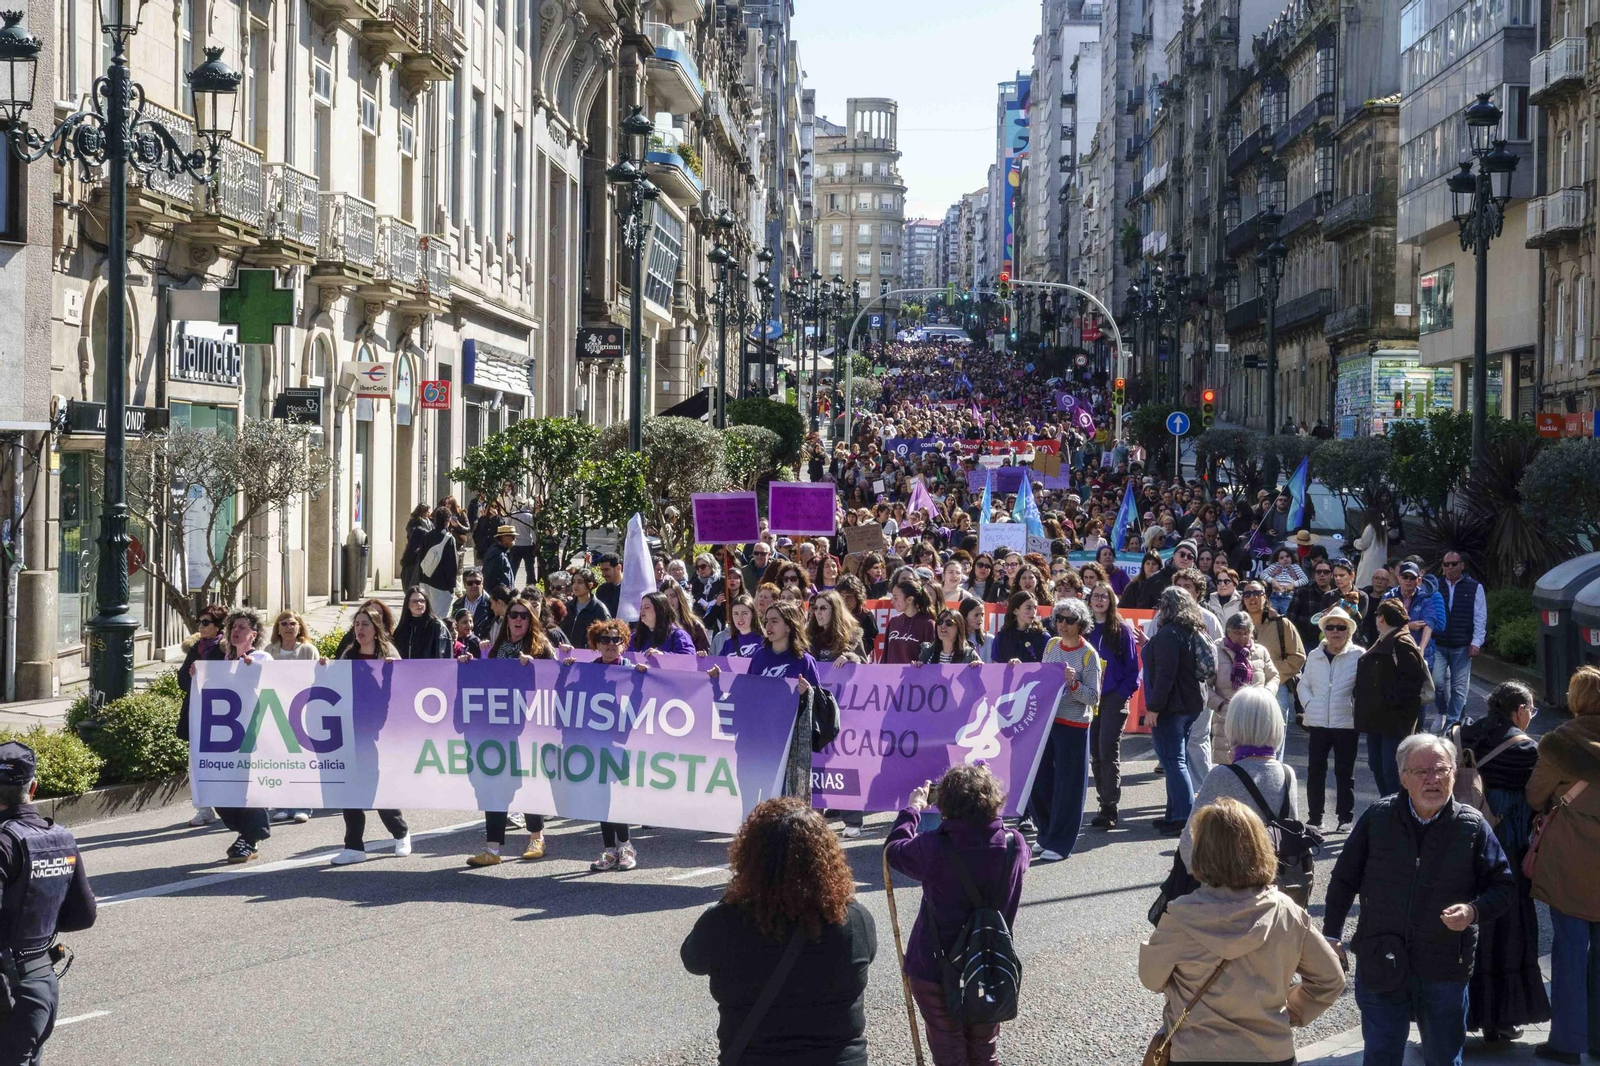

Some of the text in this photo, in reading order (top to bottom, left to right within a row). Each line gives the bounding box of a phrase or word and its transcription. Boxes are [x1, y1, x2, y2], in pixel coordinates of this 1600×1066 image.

[199, 686, 344, 754] BAG
[413, 687, 736, 741] O FEMINISMO É
[1013, 694, 1038, 734] AS FURIAS
[199, 759, 346, 771] Bloque Abolicionista Galicia
[413, 738, 739, 797] ABOLICIONISTA
[257, 776, 283, 789] Vigo
[30, 865, 75, 879] NACIONAL
[31, 856, 69, 870] POLICIA
